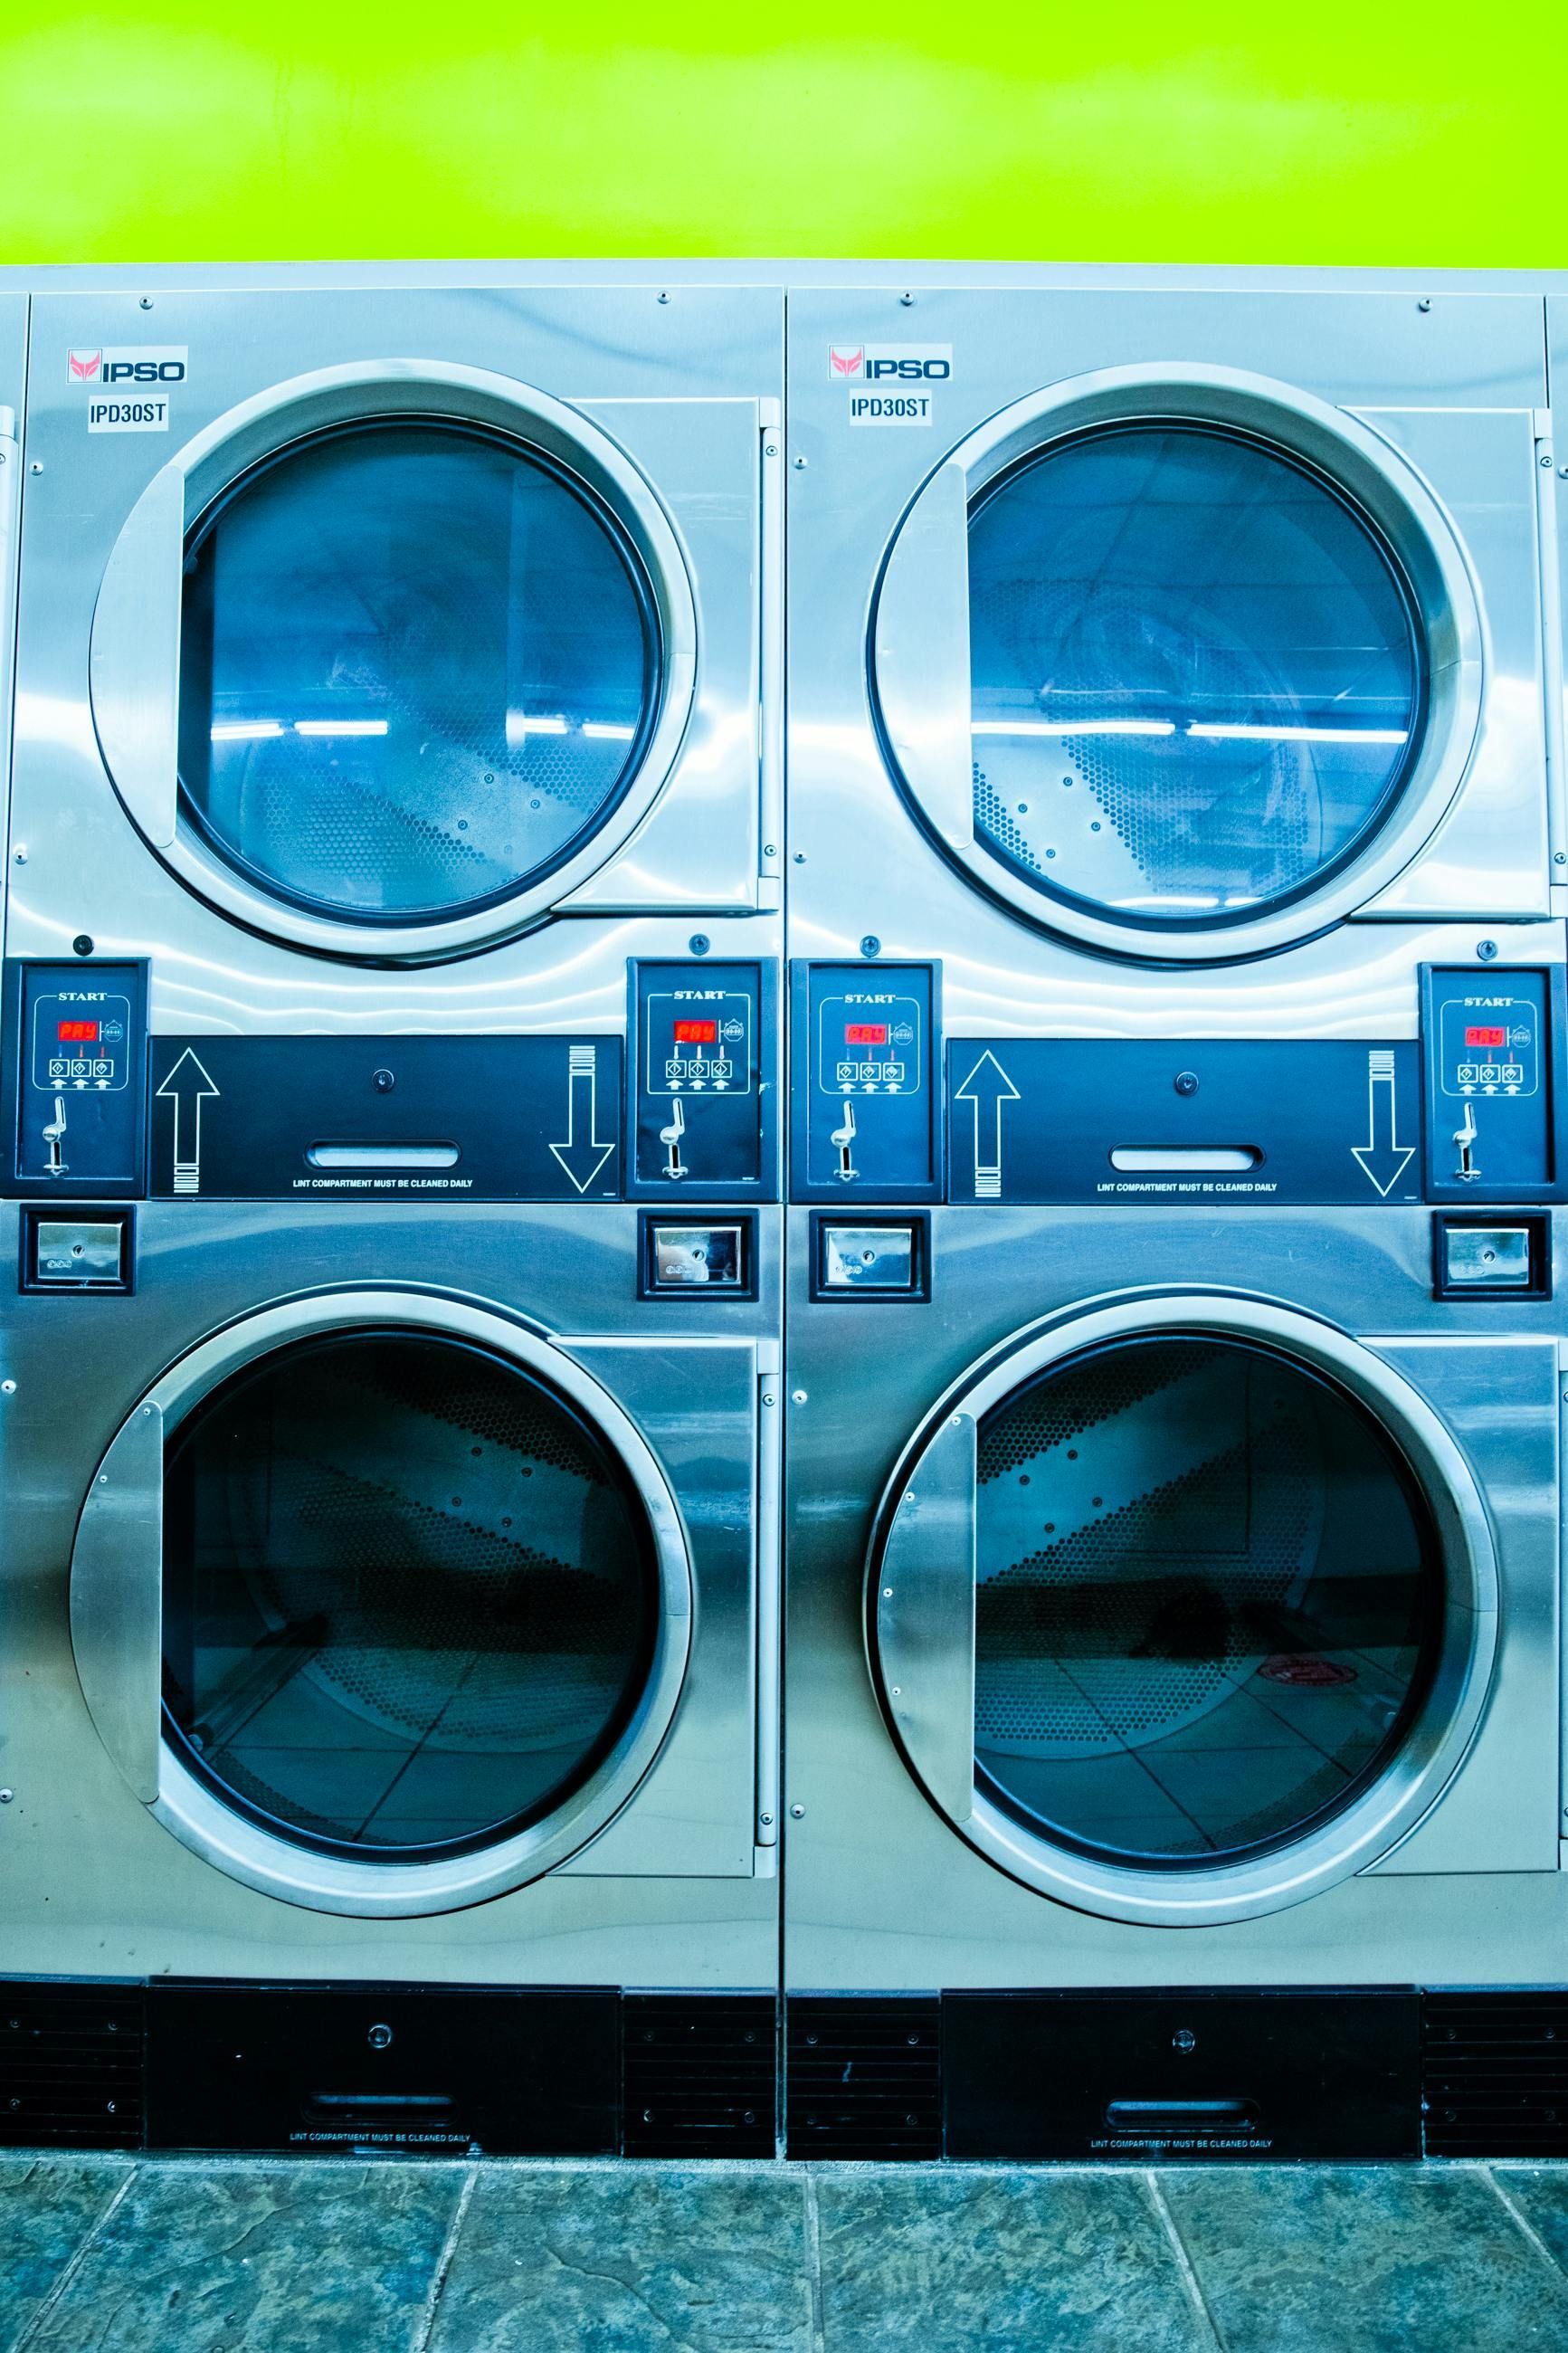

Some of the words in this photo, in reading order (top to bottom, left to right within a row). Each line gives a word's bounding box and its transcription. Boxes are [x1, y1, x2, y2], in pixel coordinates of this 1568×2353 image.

[102, 361, 185, 383] IPSO
[866, 359, 950, 379] IPSO
[851, 398, 930, 416] IPD30ST
[90, 403, 166, 424] IPD30ST
[58, 992, 108, 1001] START
[673, 990, 727, 1000] START
[844, 994, 897, 1004] START
[1464, 997, 1514, 1007] START
[293, 1179, 310, 1187] LINT
[311, 1179, 372, 1187] COMPARTMENT
[374, 1179, 396, 1187] MUST
[397, 1179, 409, 1187] BE
[411, 1179, 448, 1187] CLEANED
[450, 1179, 473, 1187] DAILY
[1098, 1183, 1115, 1191] LINT
[1116, 1183, 1177, 1191] COMPARTMENT
[1178, 1183, 1201, 1191] MUST
[1202, 1183, 1214, 1191] BE
[1215, 1183, 1253, 1191] CLEANED
[1255, 1183, 1277, 1191] DAILY
[309, 2133, 370, 2141] COMPARTMENT
[408, 2134, 446, 2142] CLEANED
[448, 2134, 470, 2142] DAILY
[1091, 2139, 1108, 2148] LINT
[1110, 2139, 1172, 2148] COMPARTMENT
[1173, 2139, 1195, 2148] MUST
[1197, 2139, 1208, 2148] BE
[1210, 2139, 1248, 2148] CLEANED
[1250, 2139, 1272, 2148] DAILY
